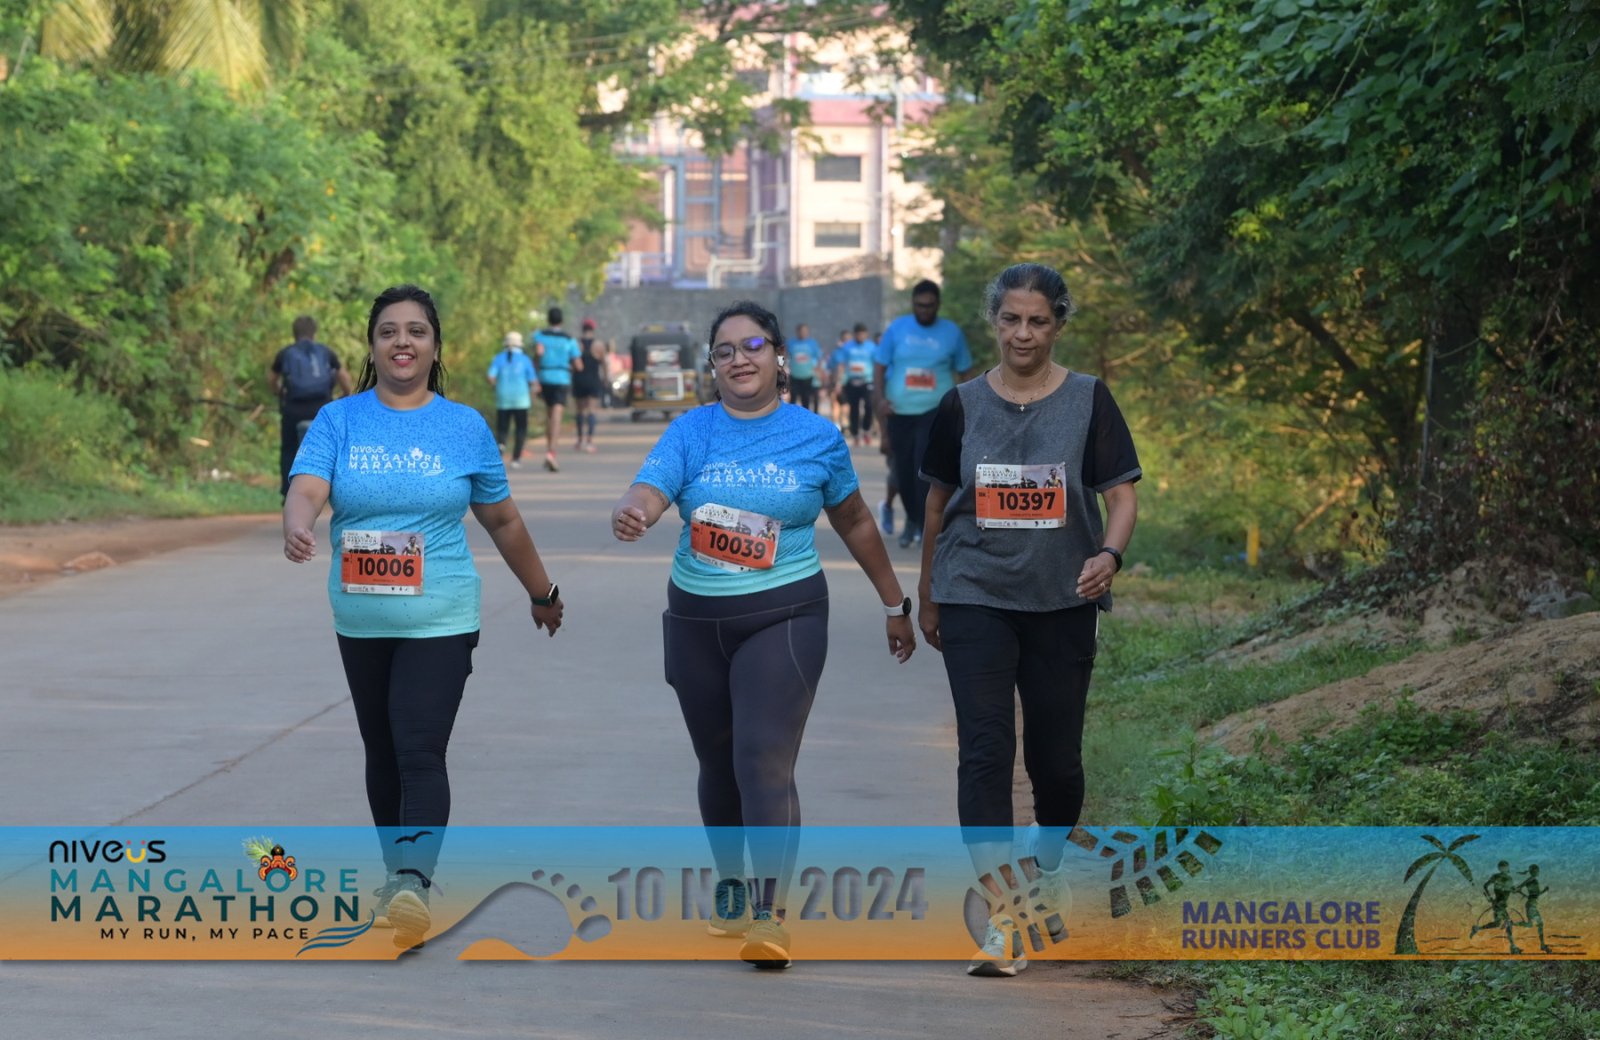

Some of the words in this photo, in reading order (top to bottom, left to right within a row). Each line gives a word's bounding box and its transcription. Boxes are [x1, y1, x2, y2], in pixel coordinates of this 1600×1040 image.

[349, 460, 441, 470] MARATHON
[350, 453, 440, 462] MANGALORE
[701, 474, 797, 486] MARATHON
[997, 491, 1056, 511] 10397
[709, 531, 766, 560] 10039
[357, 557, 415, 577] 10006
